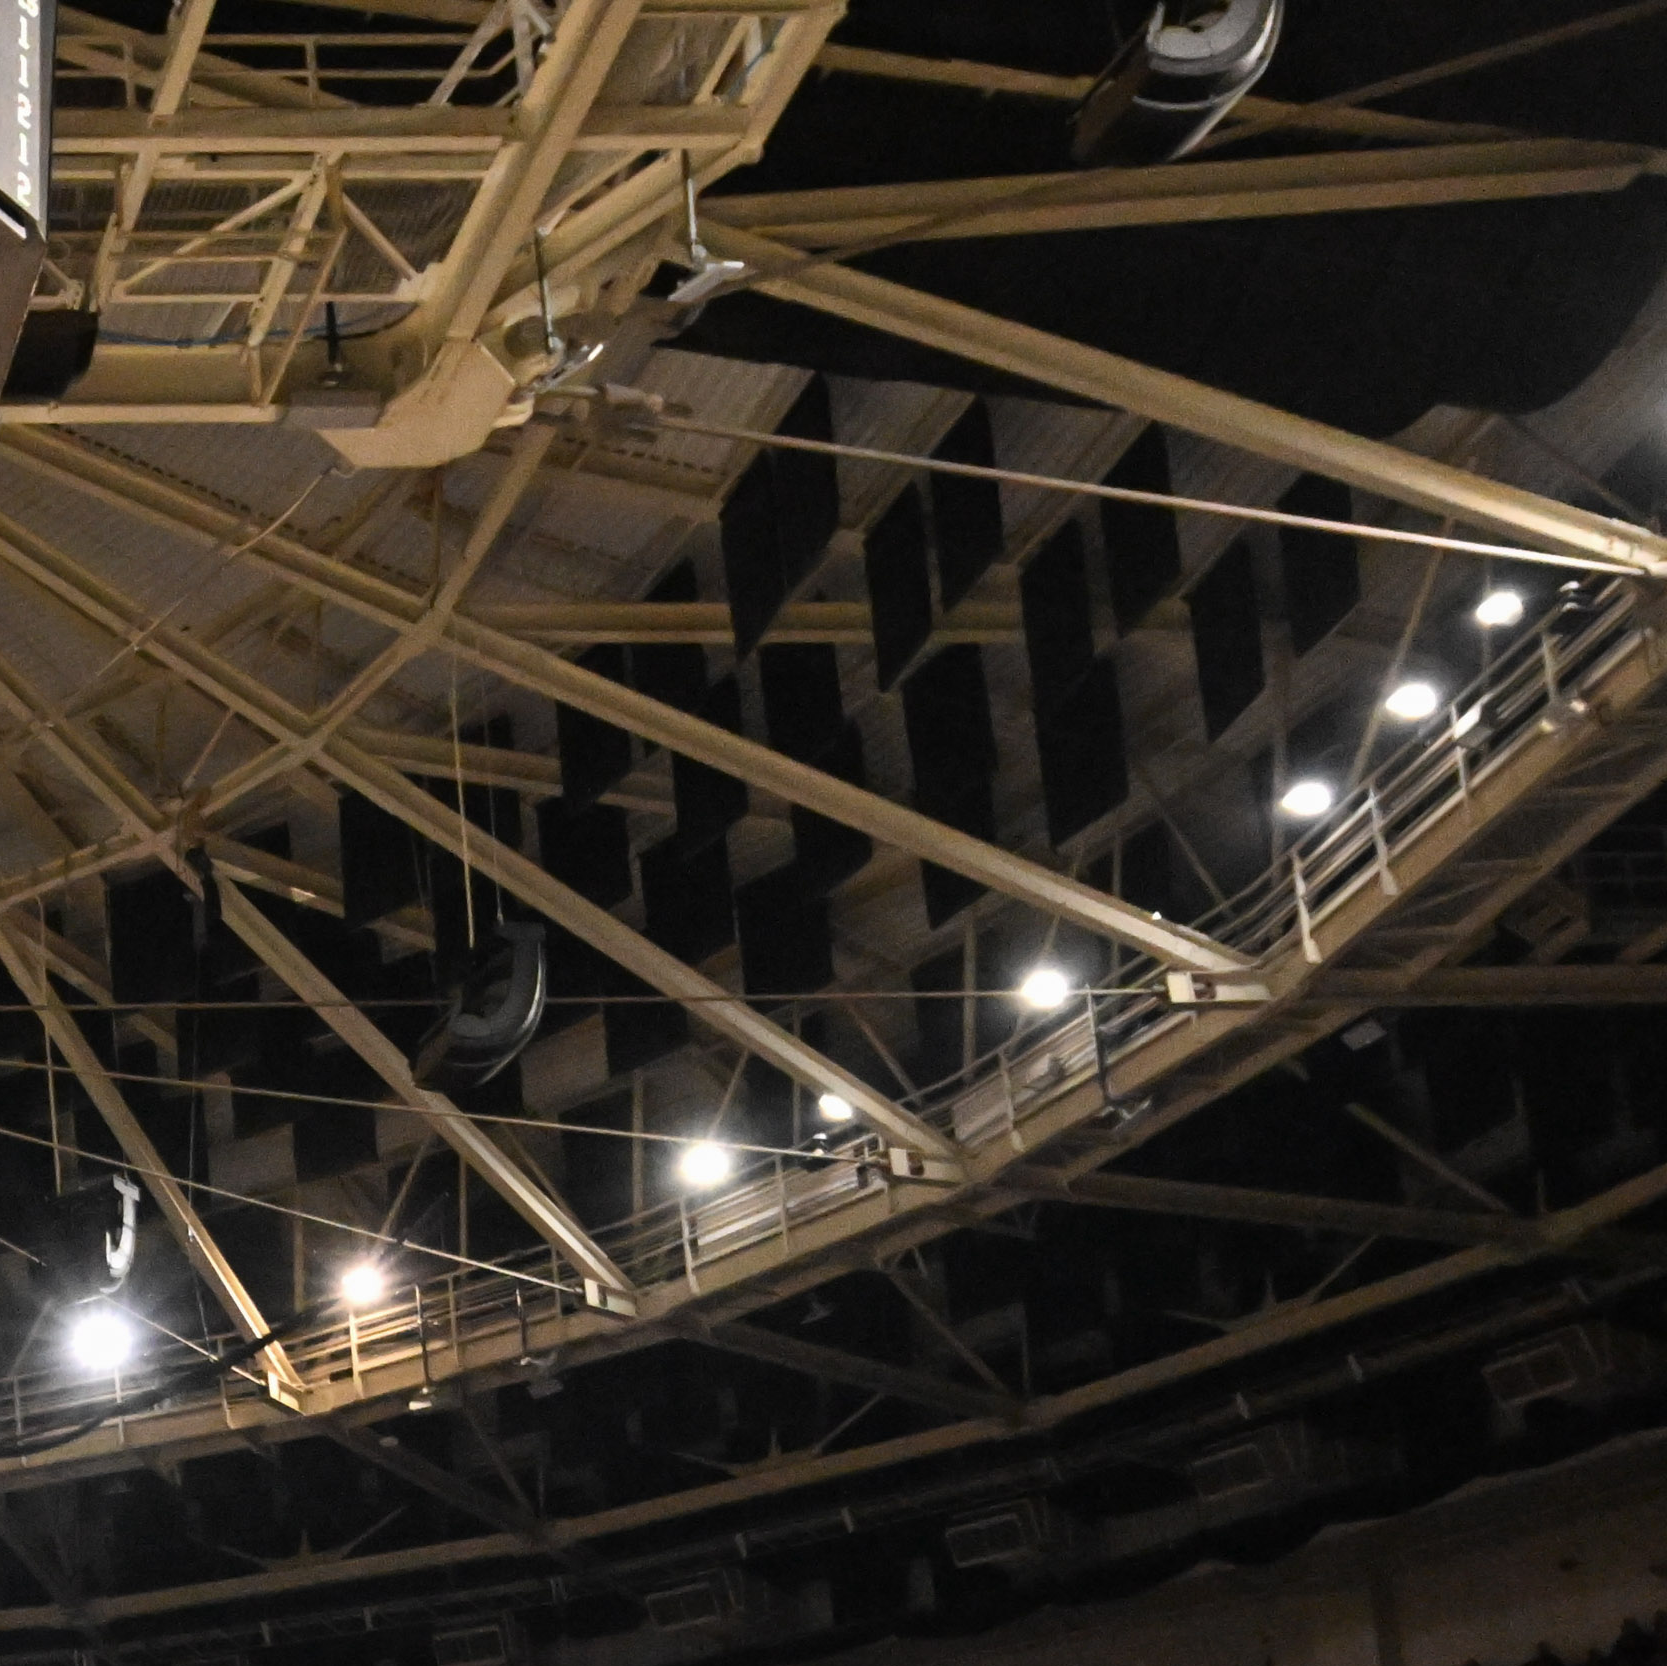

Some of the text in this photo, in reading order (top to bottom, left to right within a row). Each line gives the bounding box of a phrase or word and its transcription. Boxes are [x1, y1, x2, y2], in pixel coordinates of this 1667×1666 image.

[18, 15, 30, 50] 1
[18, 54, 29, 88] 1
[18, 93, 31, 129] 2
[18, 133, 29, 167] 1
[17, 171, 31, 207] 2
